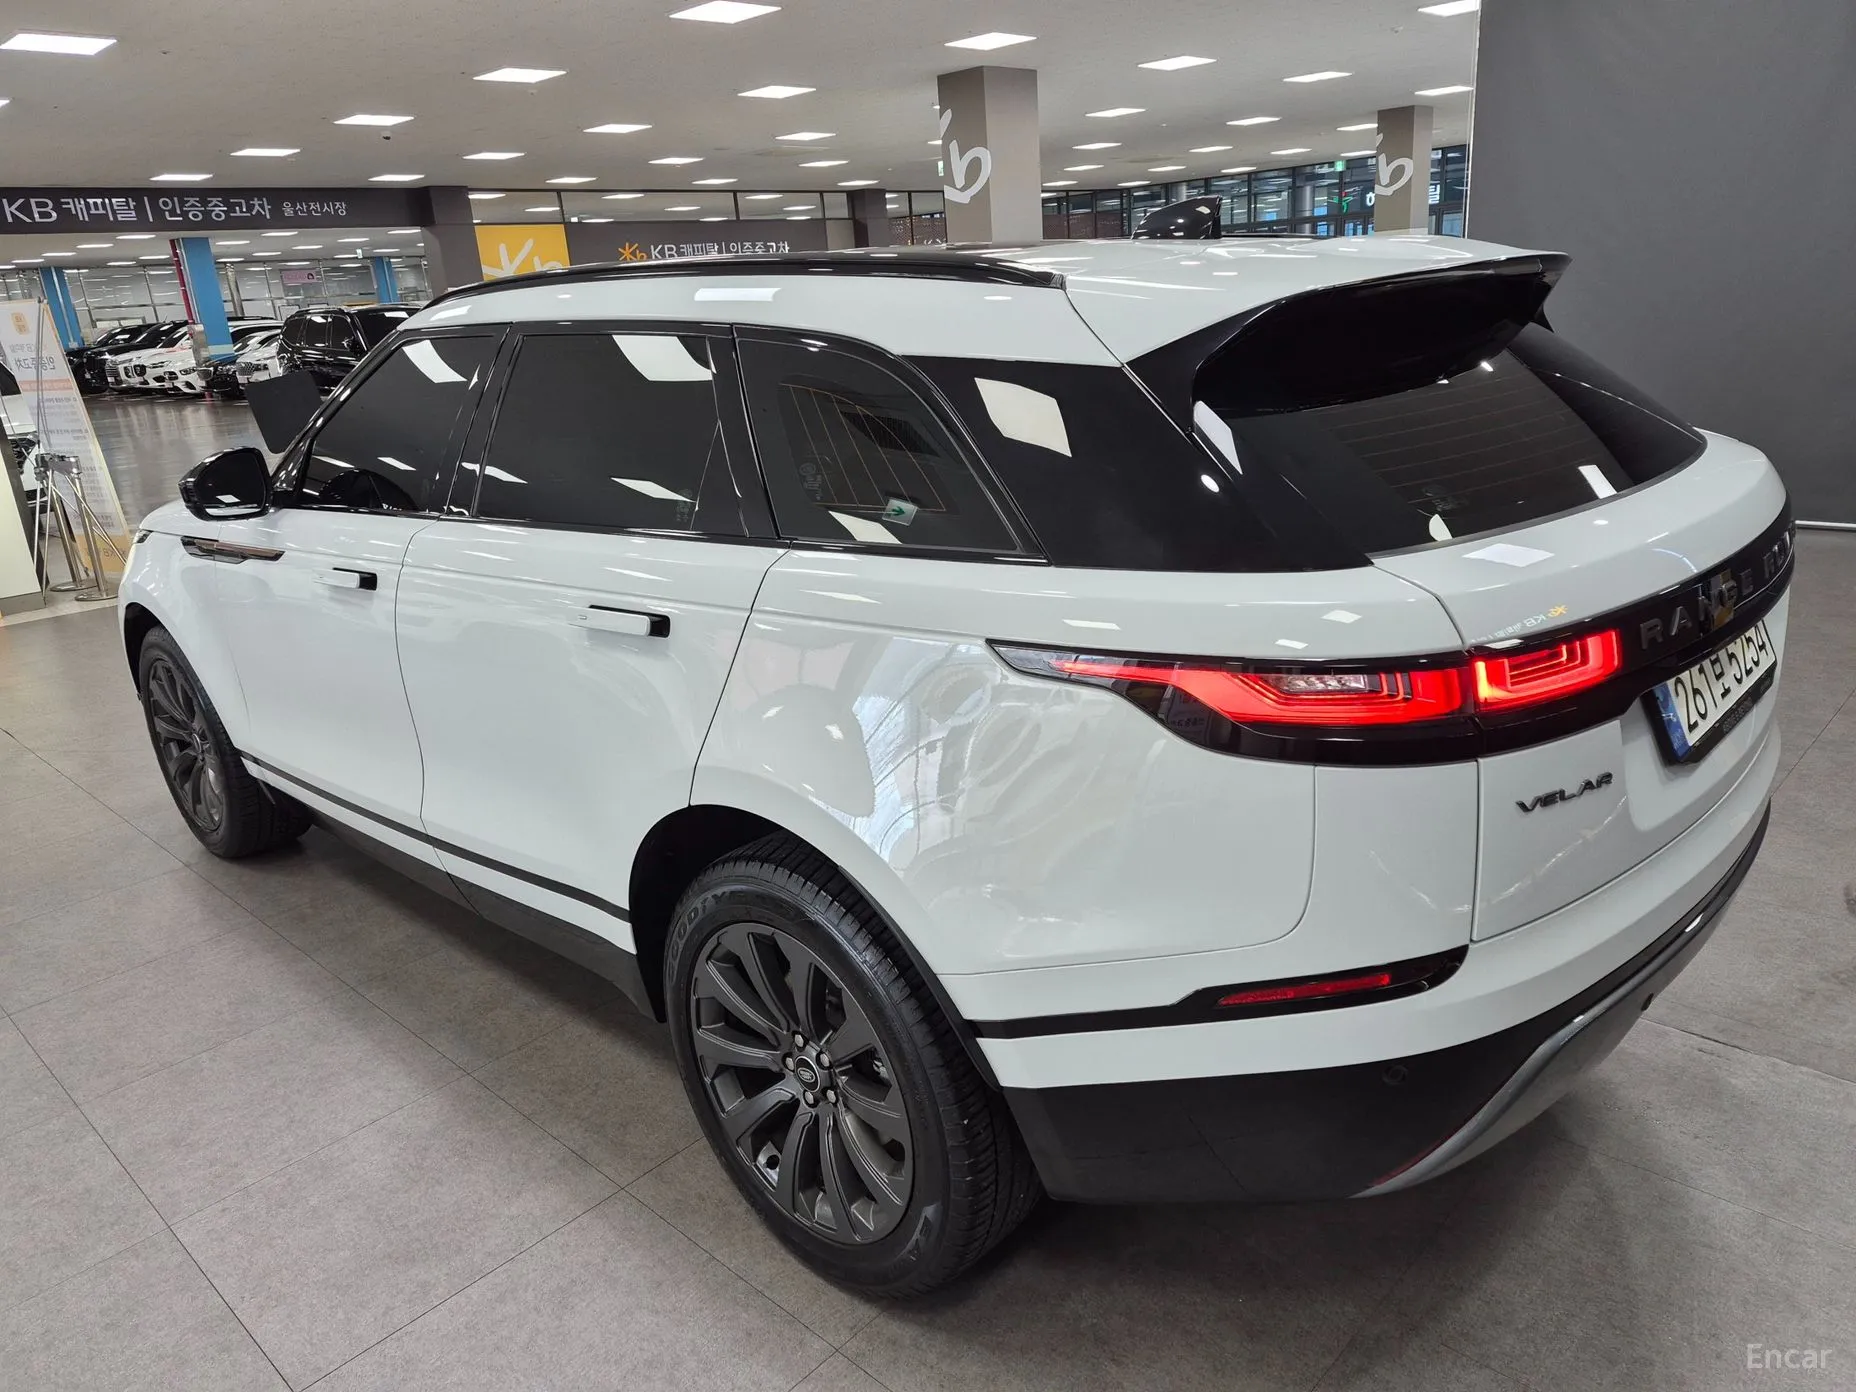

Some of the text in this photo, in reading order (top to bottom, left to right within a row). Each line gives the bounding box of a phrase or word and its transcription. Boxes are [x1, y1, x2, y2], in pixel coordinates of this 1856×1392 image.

[2, 196, 348, 223] KB 캐피탈 인증중고차 울산전시장
[1515, 771, 1613, 814] VELAR
